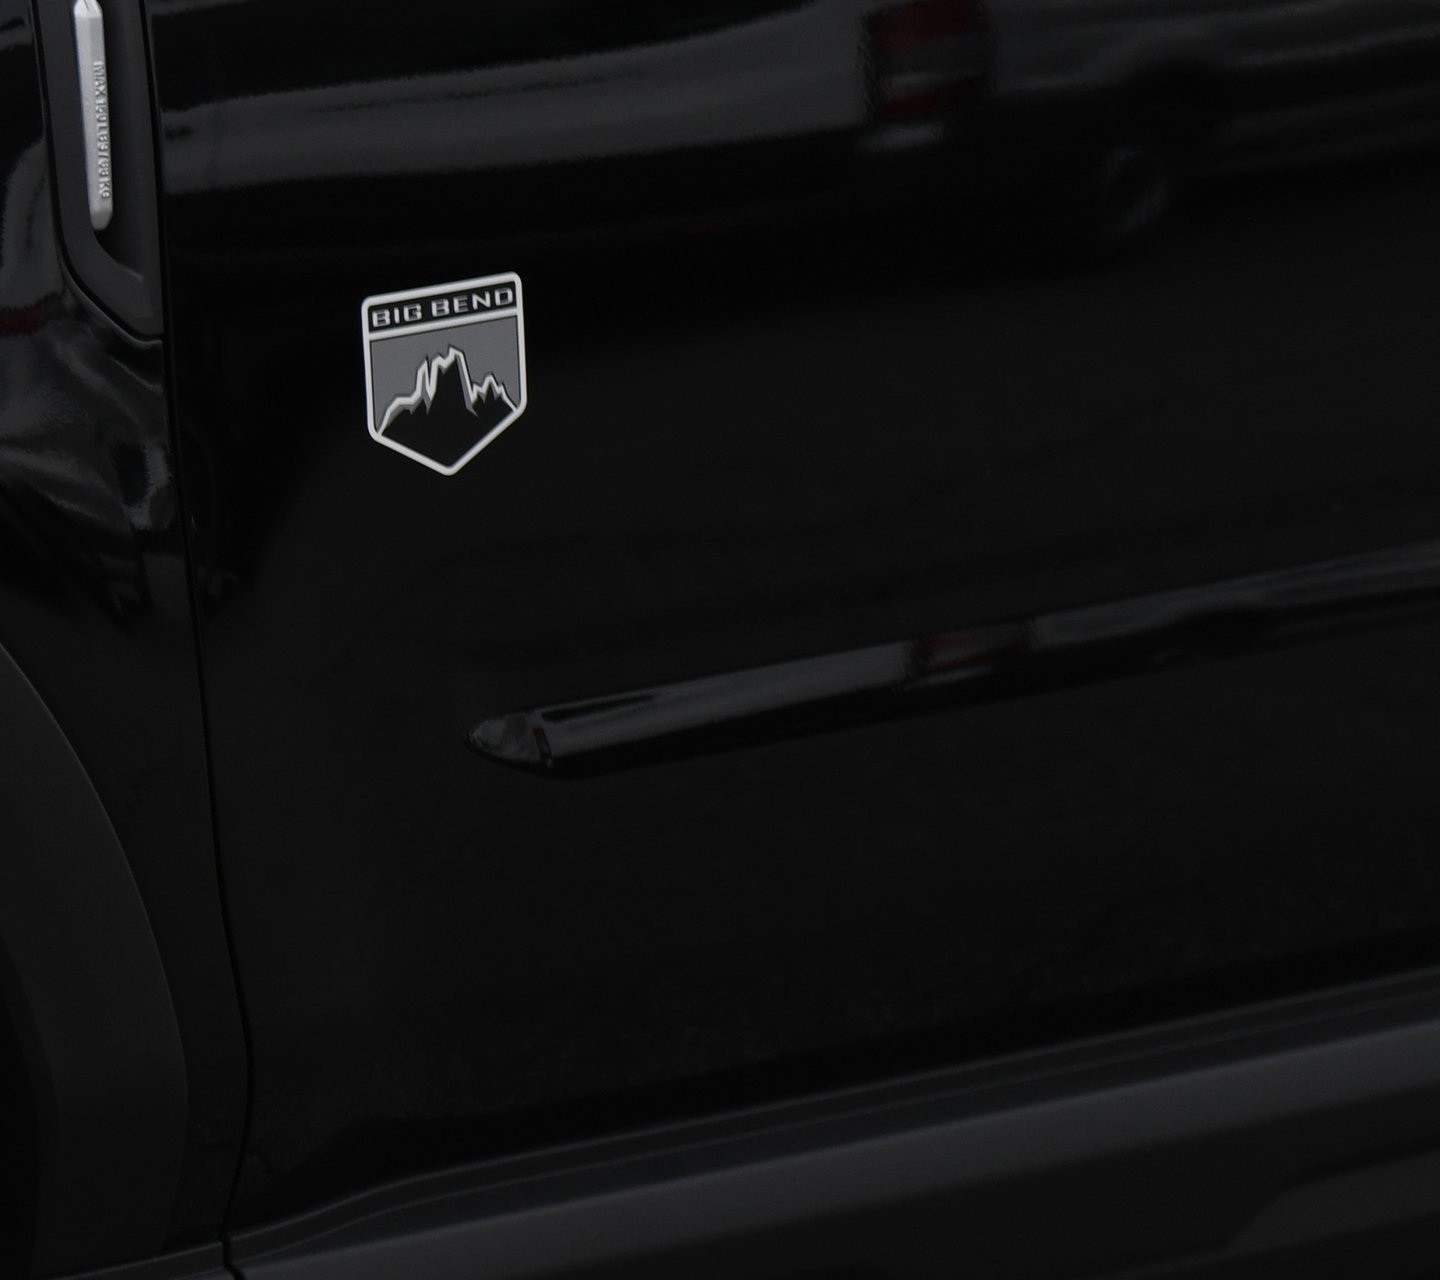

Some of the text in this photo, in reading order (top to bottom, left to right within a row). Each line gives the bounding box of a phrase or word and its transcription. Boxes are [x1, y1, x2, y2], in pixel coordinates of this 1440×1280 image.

[93, 60, 107, 96] MAX
[371, 286, 515, 328] BIG BEND
